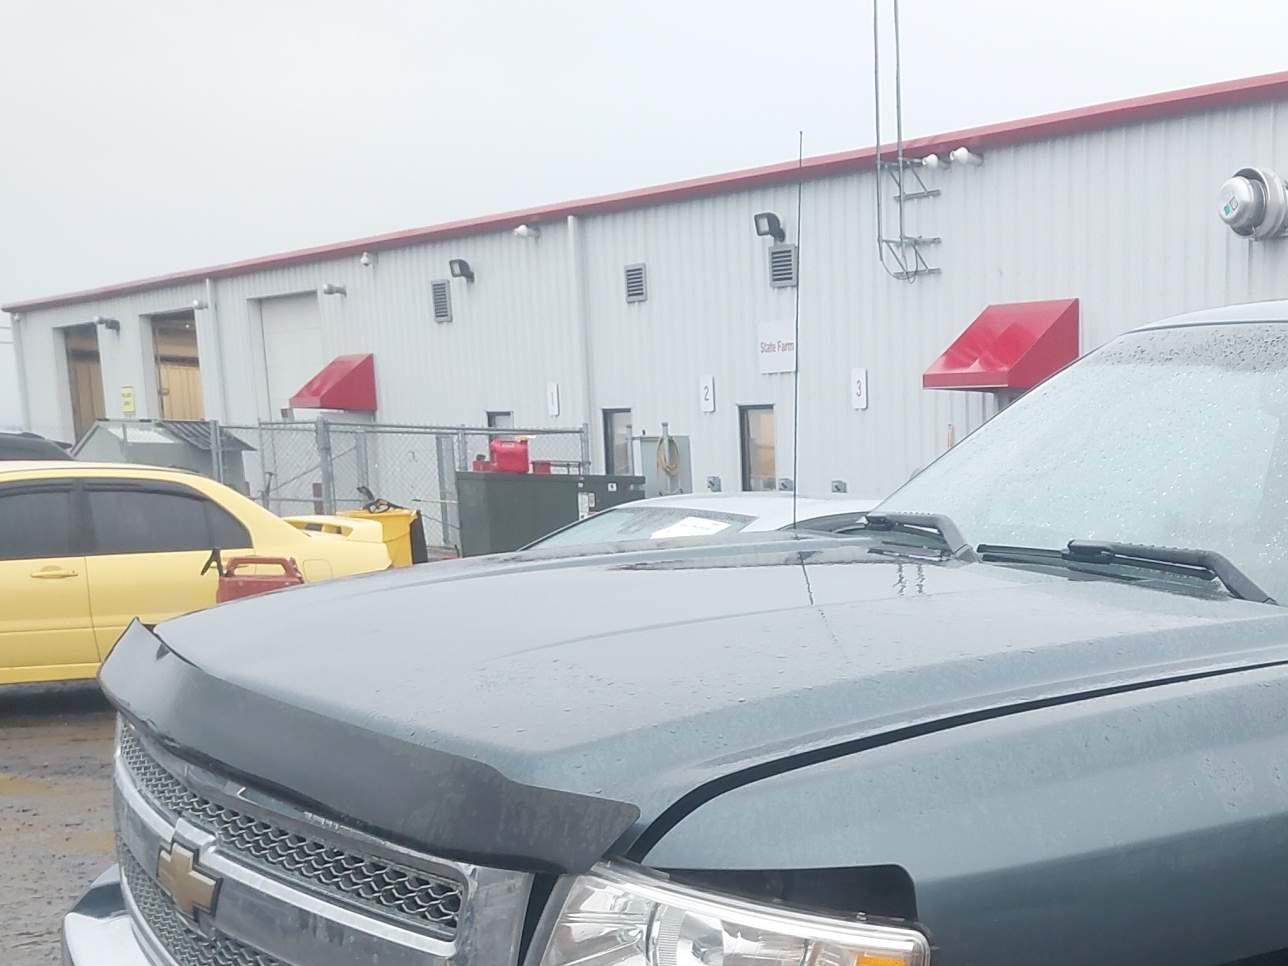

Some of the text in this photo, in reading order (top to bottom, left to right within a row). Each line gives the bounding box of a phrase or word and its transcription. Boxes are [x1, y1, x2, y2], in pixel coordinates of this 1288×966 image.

[760, 339, 795, 353] State Farm
[703, 385, 710, 401] 2
[856, 379, 862, 397] 3
